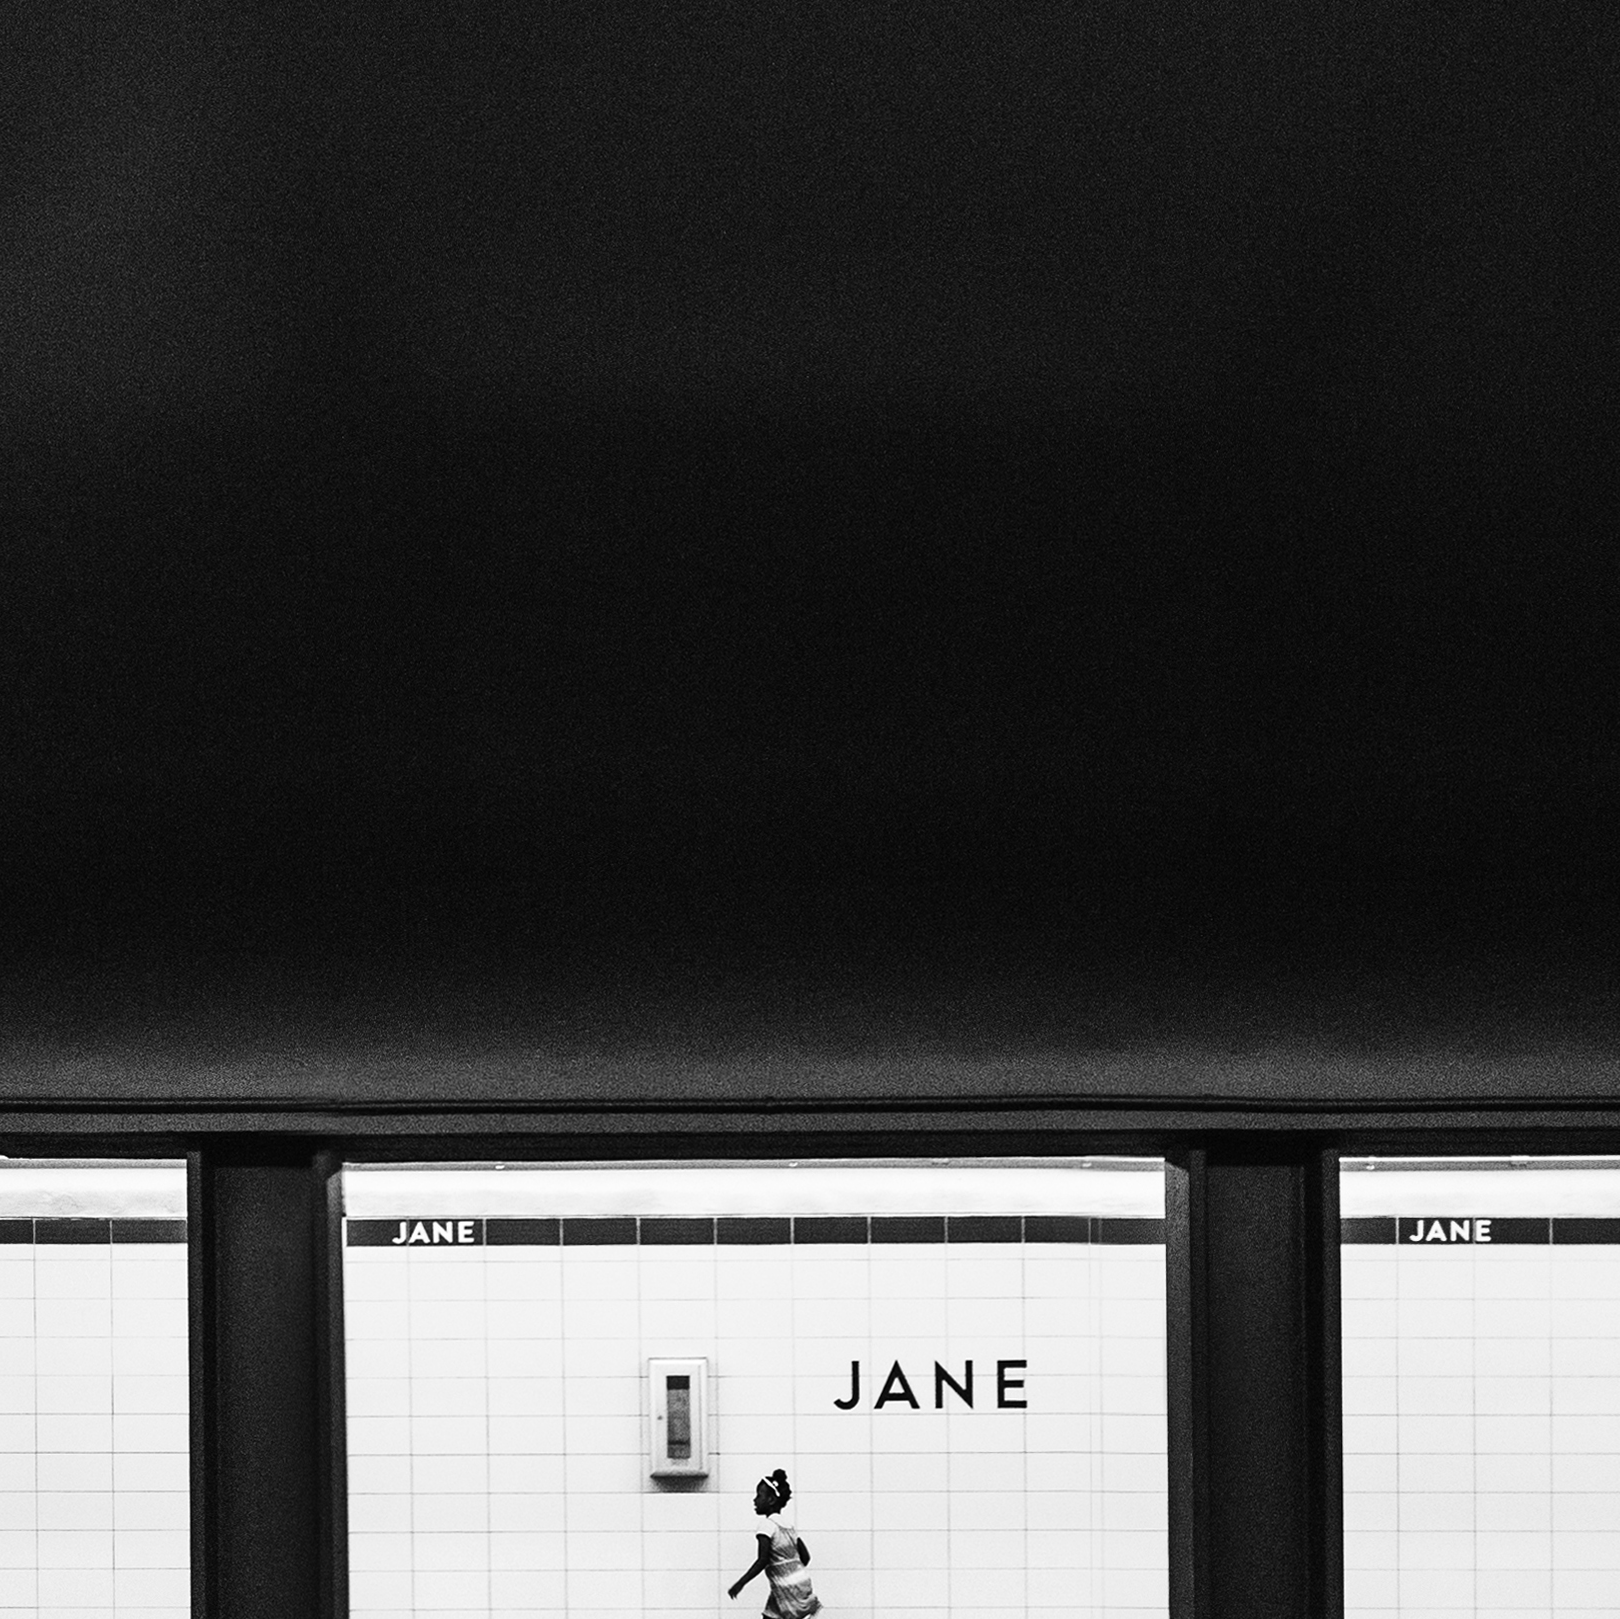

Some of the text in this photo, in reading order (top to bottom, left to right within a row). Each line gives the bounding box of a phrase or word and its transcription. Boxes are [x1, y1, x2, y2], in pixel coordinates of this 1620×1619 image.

[391, 1220, 475, 1245] JANE
[1408, 1219, 1492, 1242] JANE
[833, 1359, 1028, 1410] JANE
